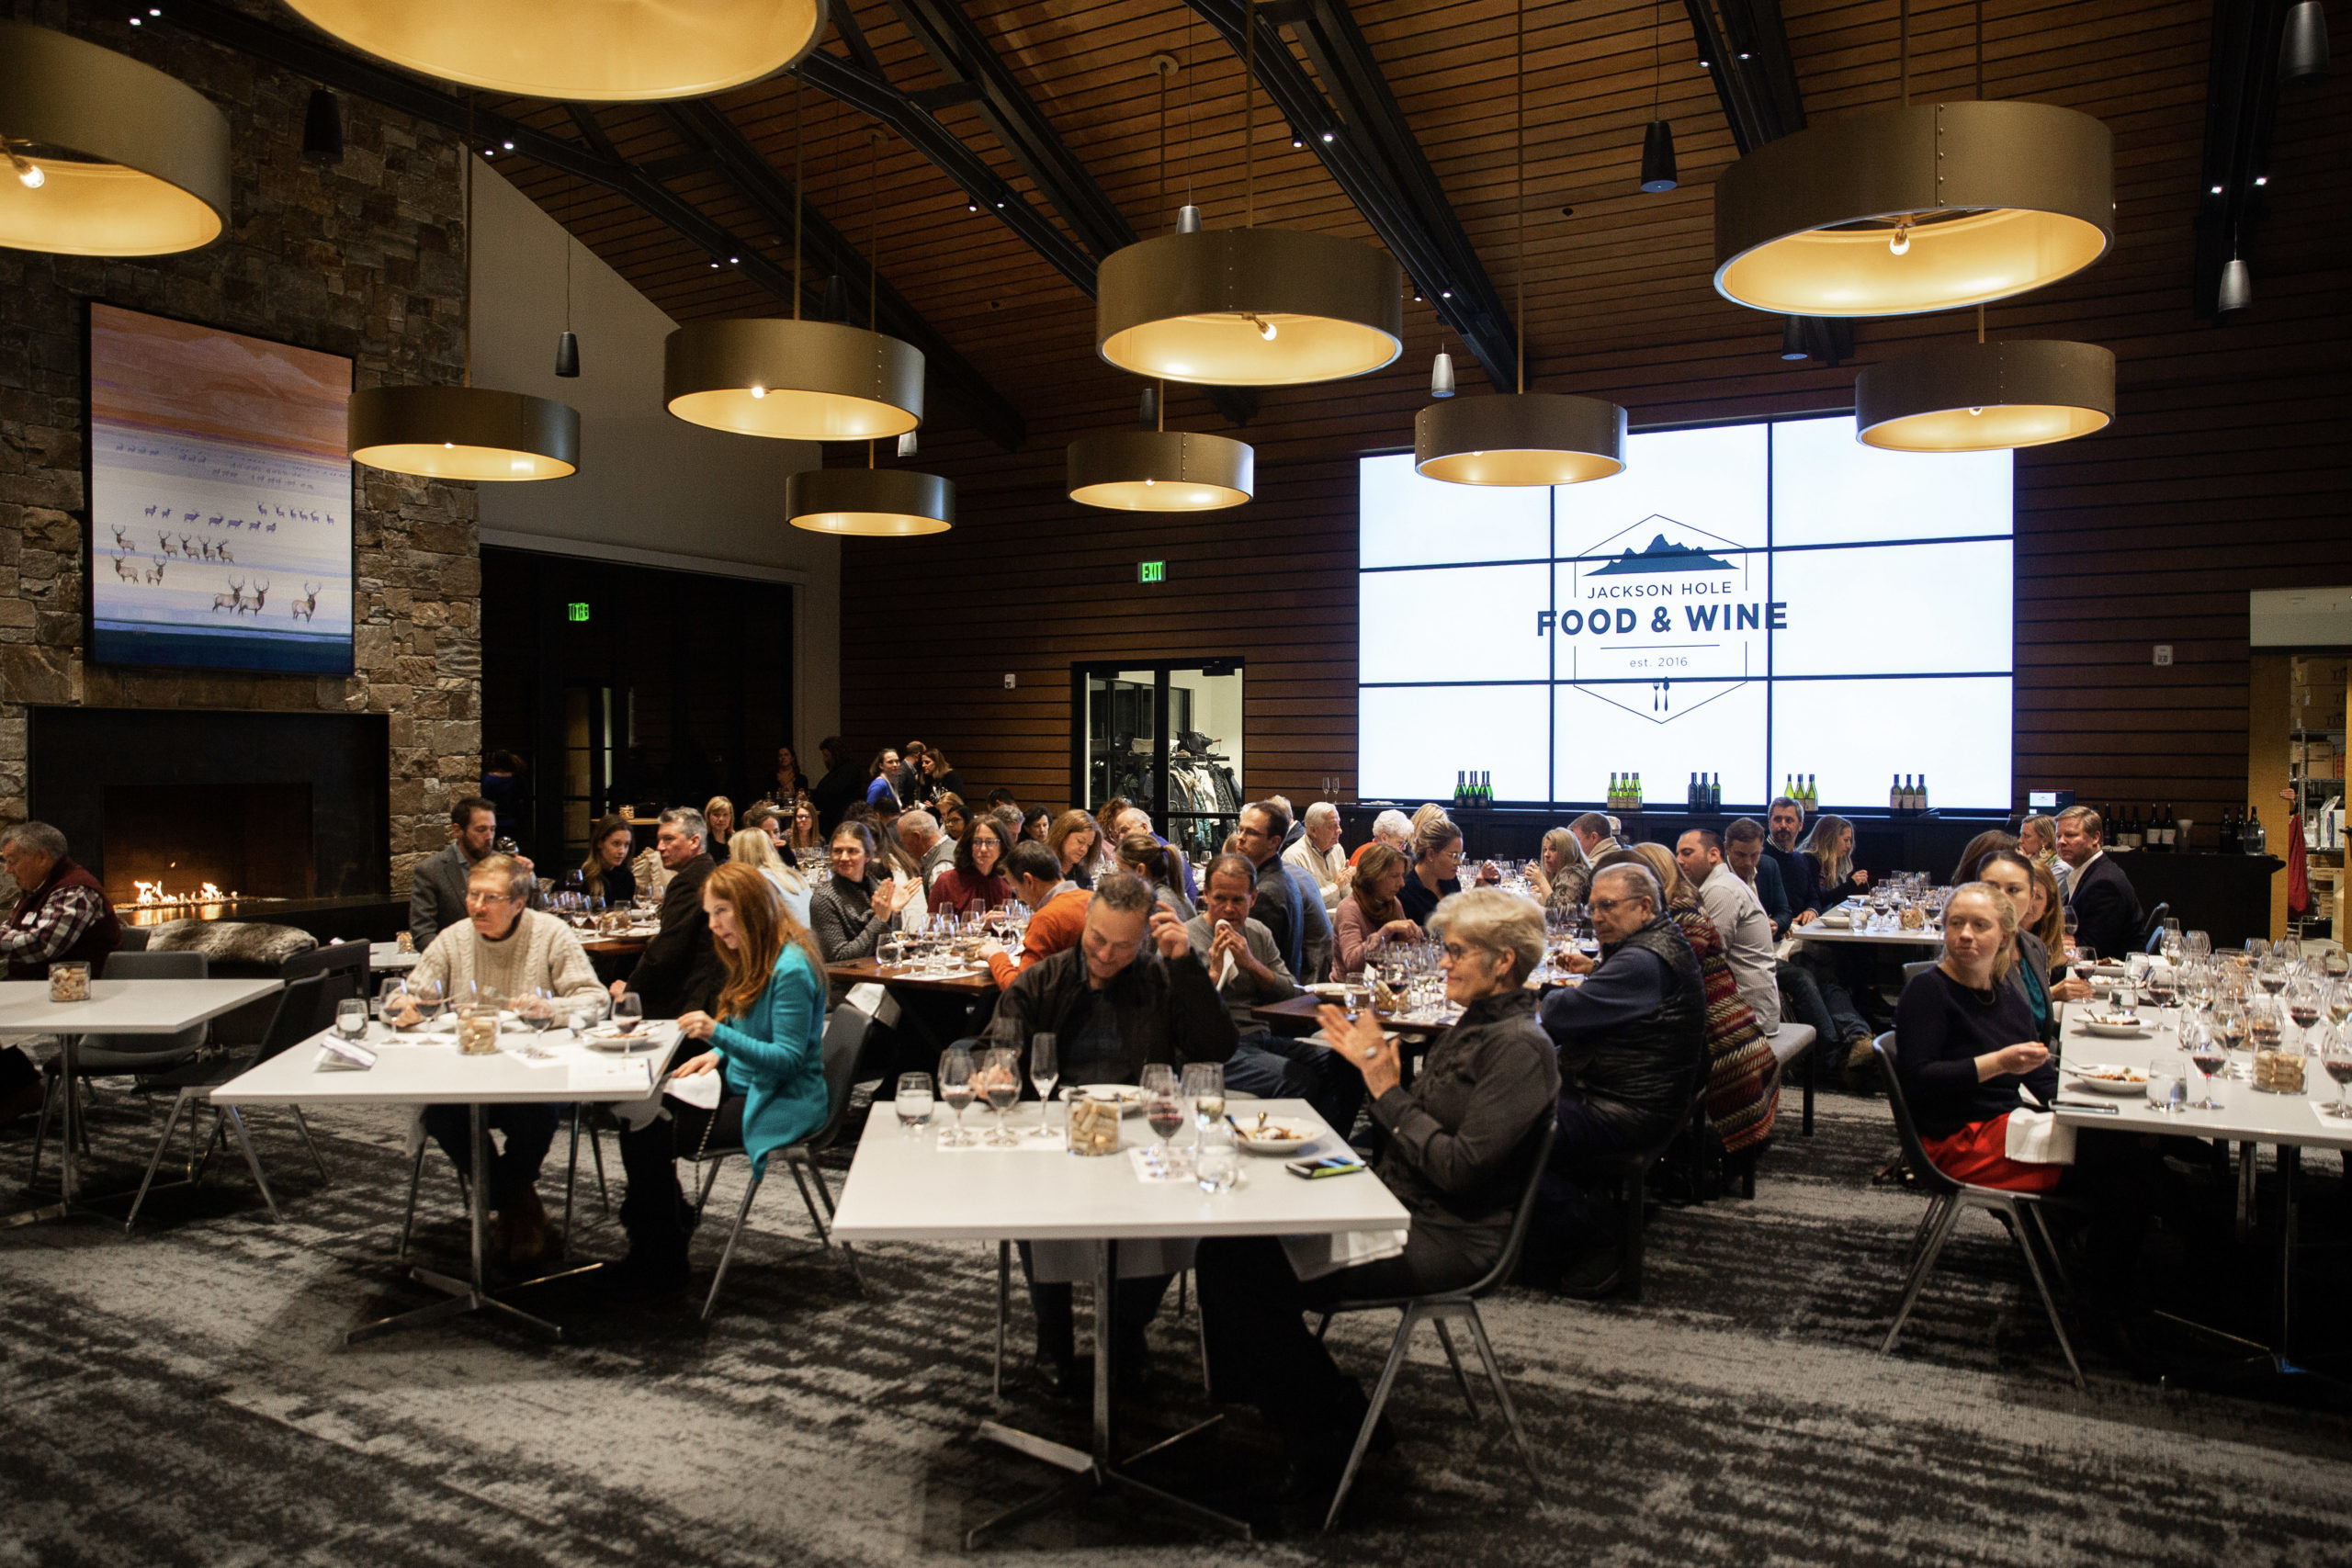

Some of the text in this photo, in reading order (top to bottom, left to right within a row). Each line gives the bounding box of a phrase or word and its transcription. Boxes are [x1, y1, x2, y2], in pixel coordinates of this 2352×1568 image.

[1142, 561, 1163, 581] EXIT
[1587, 581, 1732, 599] JACKSON HOLE
[1537, 602, 1787, 637] FOOD & WINE
[1629, 657, 1688, 668] est. 2016
